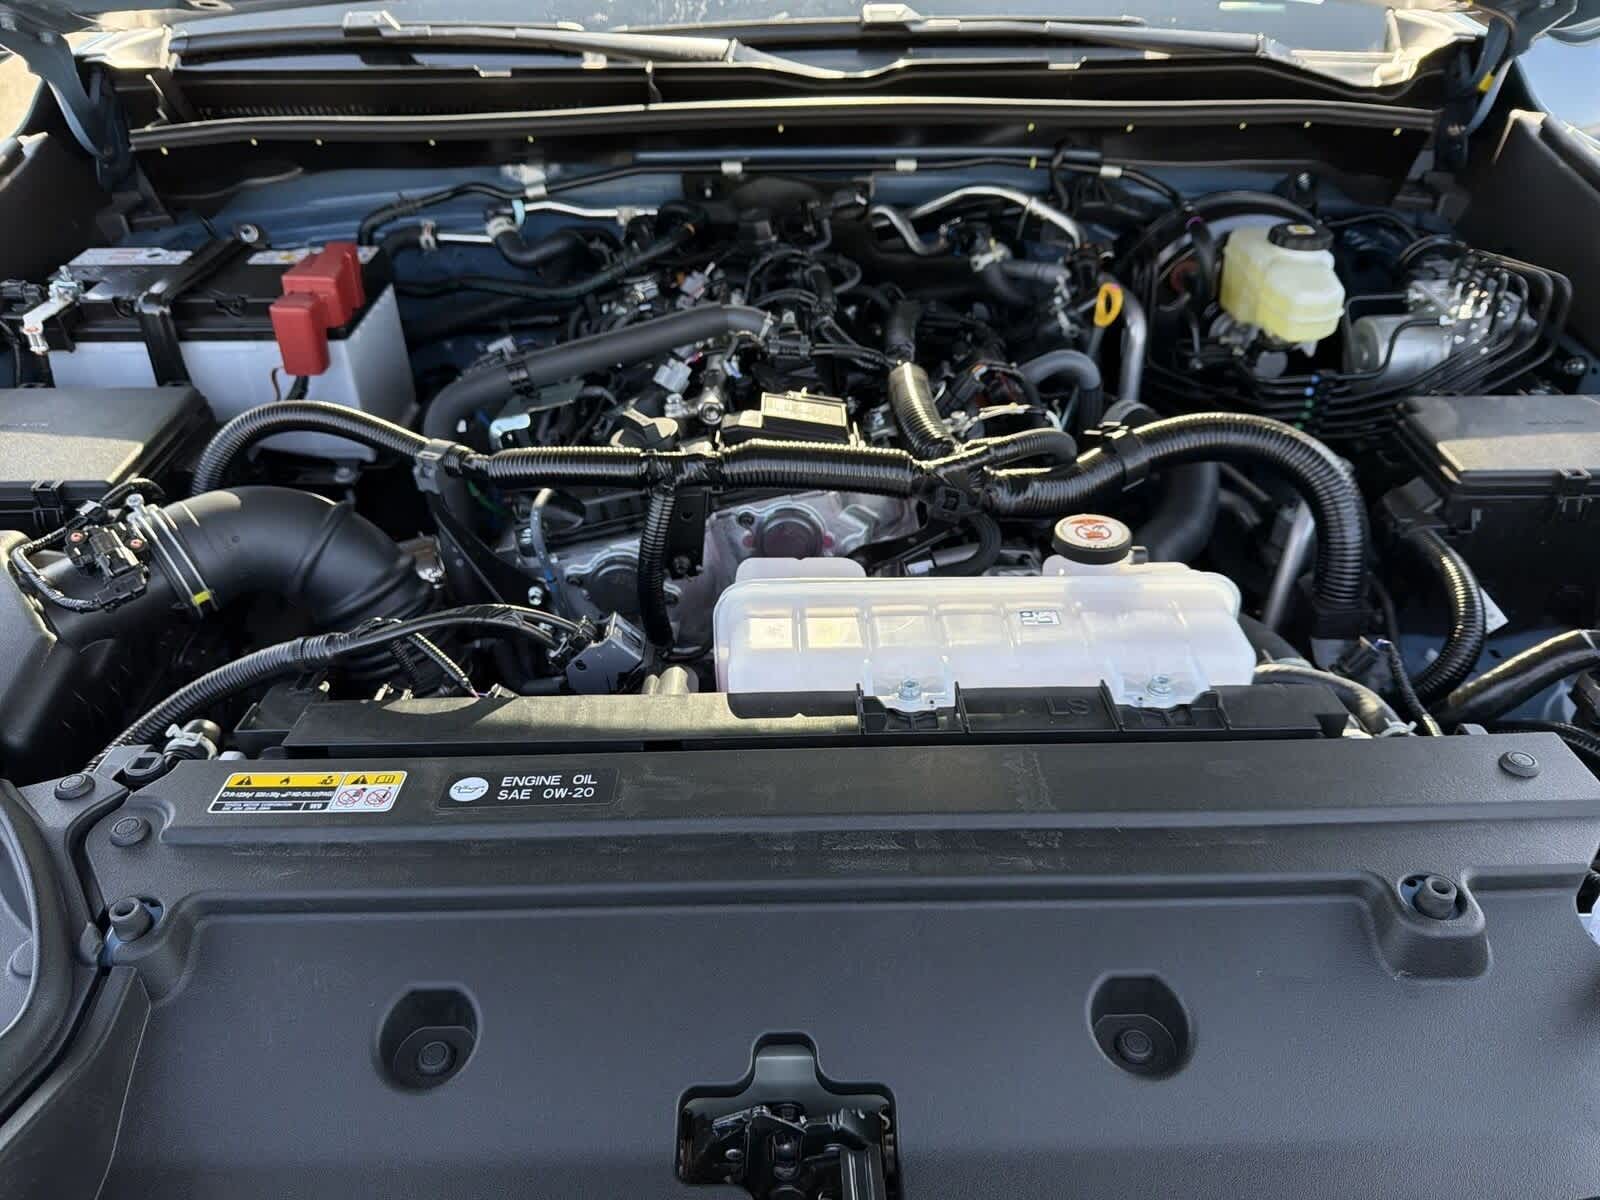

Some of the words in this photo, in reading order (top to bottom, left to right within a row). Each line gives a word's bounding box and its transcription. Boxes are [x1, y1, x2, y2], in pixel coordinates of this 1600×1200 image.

[501, 775, 562, 787] ENGINE
[572, 774, 598, 785] OIL
[497, 788, 533, 800] SAE
[543, 787, 595, 799] 0W-20
